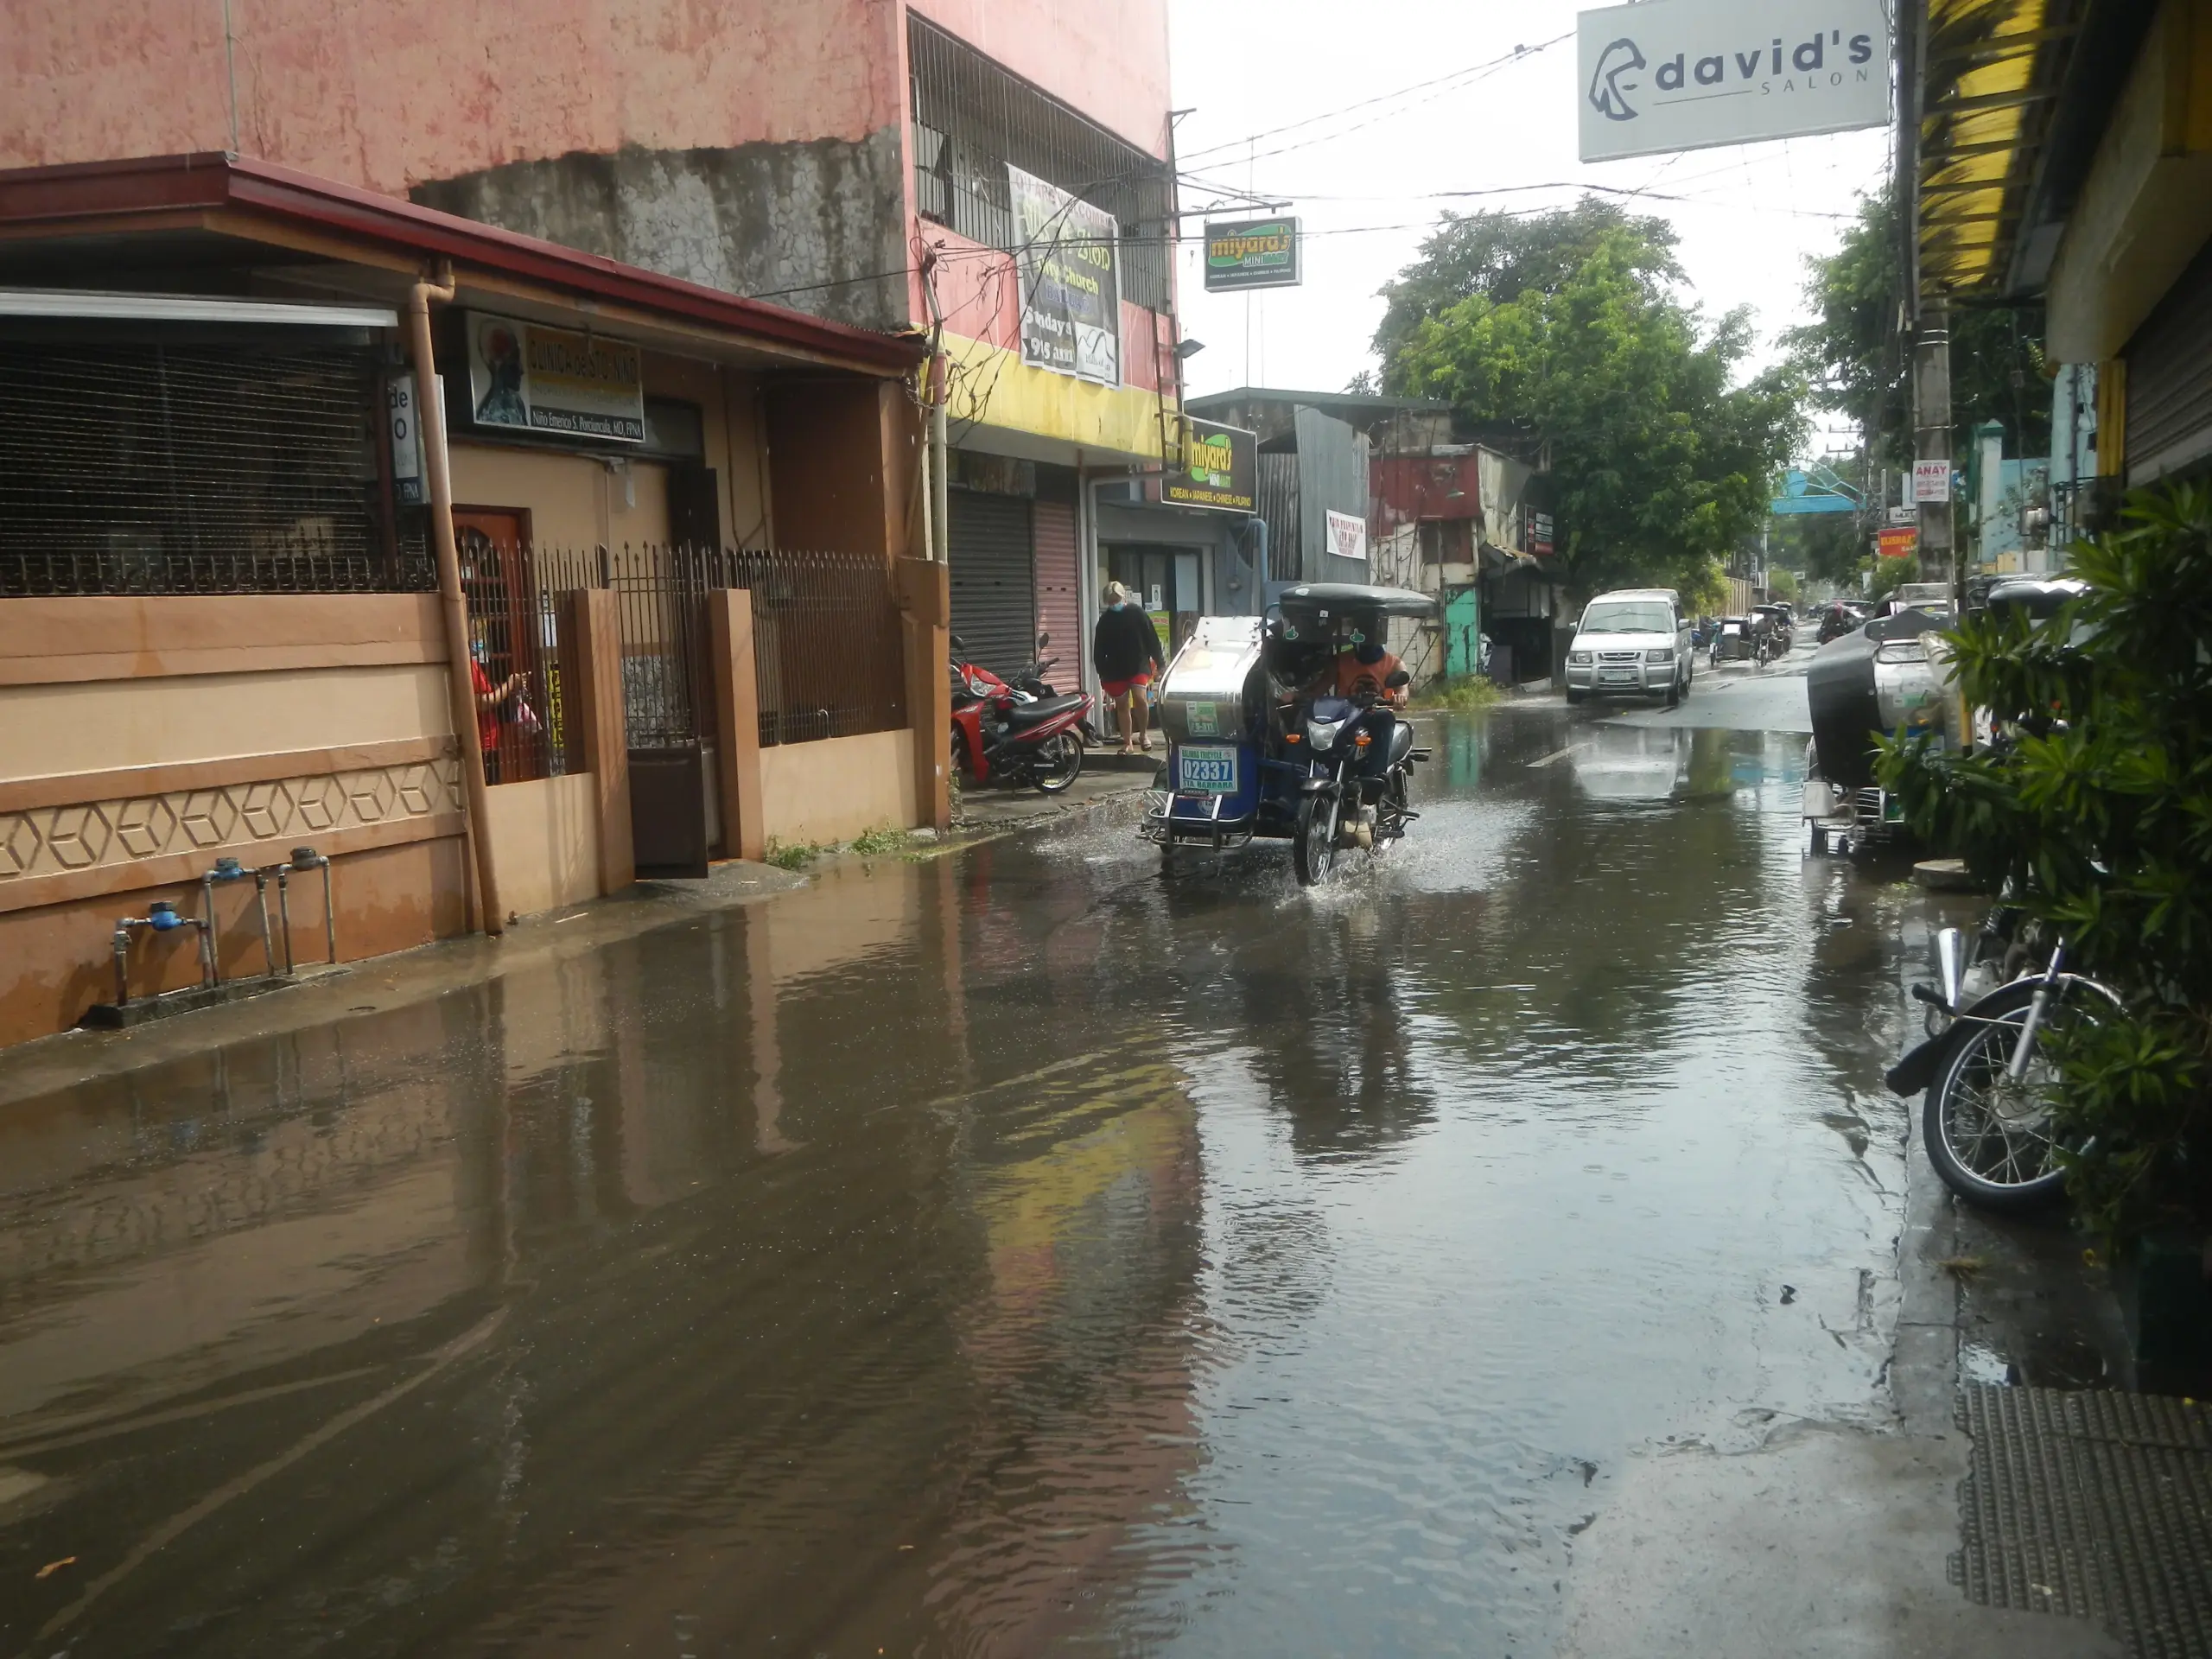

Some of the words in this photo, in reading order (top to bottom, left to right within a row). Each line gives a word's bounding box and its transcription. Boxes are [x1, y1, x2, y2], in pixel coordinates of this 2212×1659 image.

[1655, 29, 1872, 91] david's
[1761, 68, 1869, 95] SALON
[1210, 225, 1291, 261] miyara's
[1244, 256, 1264, 265] MINI
[532, 410, 548, 426] Niño
[1192, 434, 1232, 476] miyara's
[1916, 466, 1947, 476] ANAY
[1170, 486, 1189, 499] KOREAN
[1192, 489, 1213, 502] JAPANESE
[1216, 493, 1233, 505] CHINESE
[1184, 760, 1230, 780] 02337
